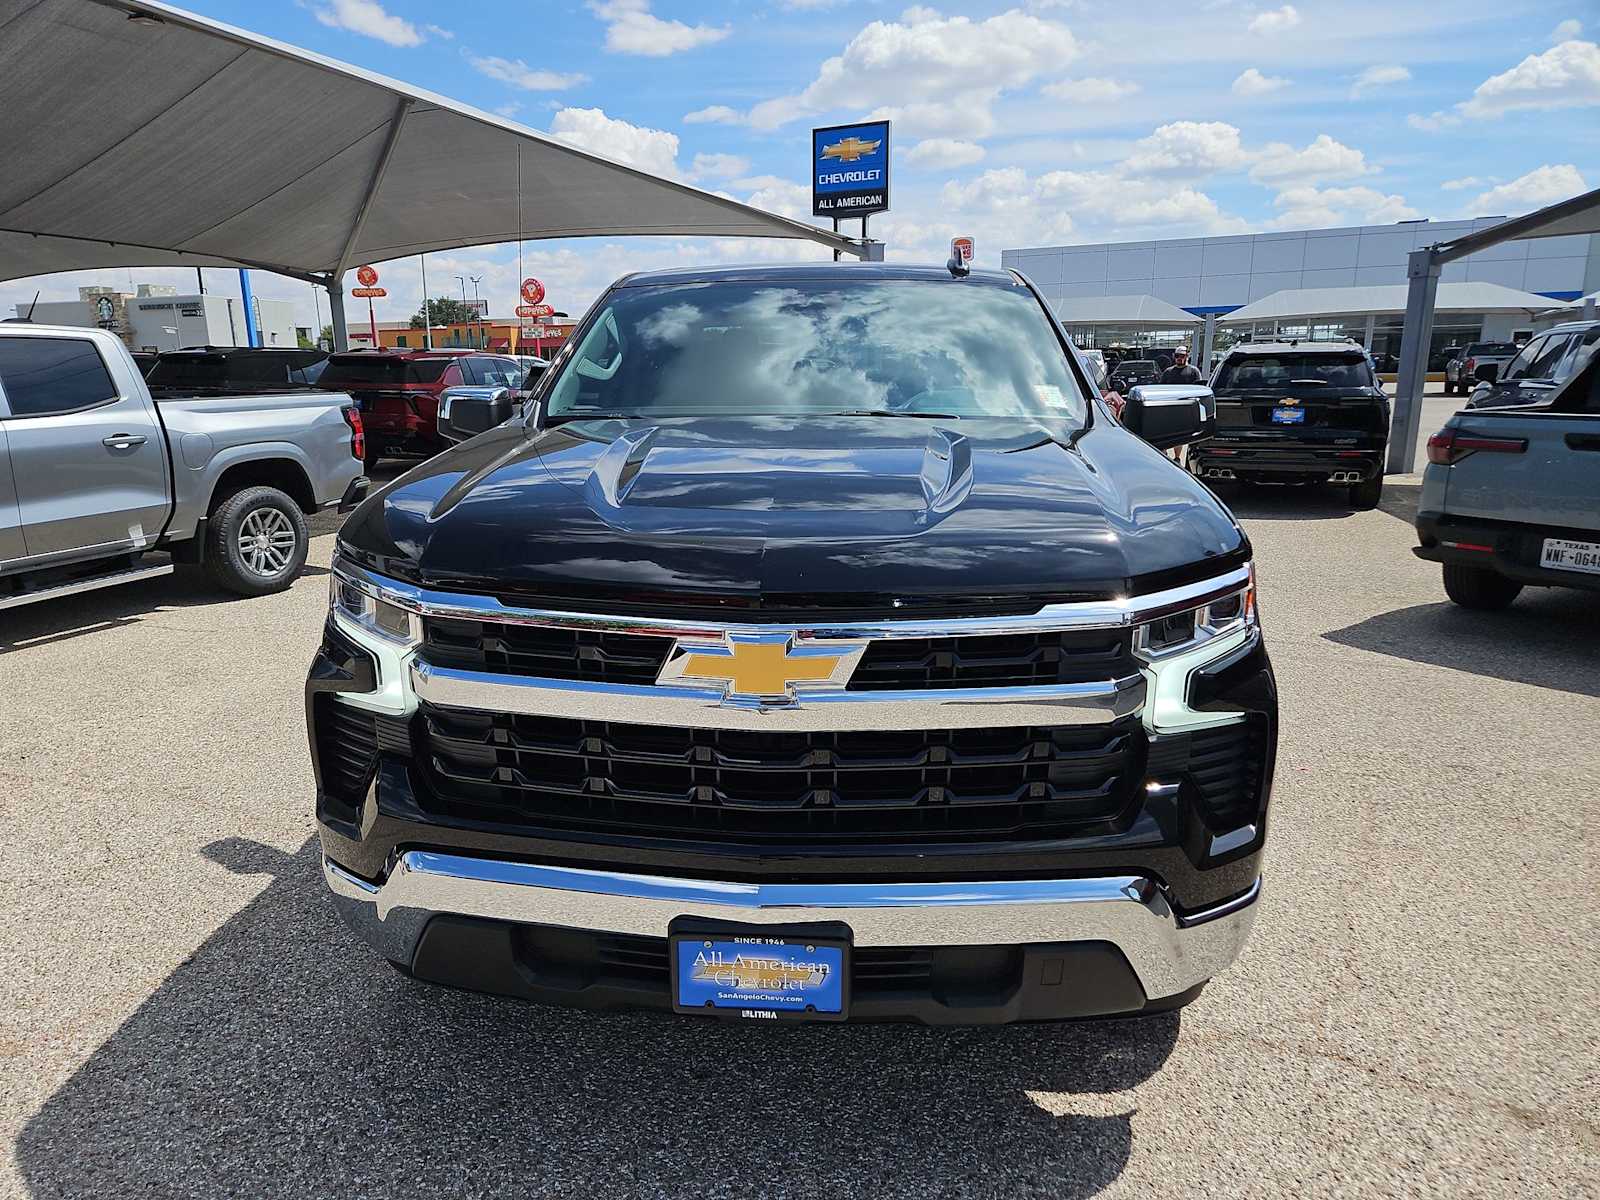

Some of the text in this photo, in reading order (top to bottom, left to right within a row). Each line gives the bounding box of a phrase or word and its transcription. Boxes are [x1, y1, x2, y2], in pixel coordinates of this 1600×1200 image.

[818, 169, 881, 185] CHEVROLET
[818, 194, 882, 209] ALL AMERICAN
[1564, 542, 1590, 551] TEXAS
[734, 937, 762, 945] SINCE
[693, 951, 831, 974] All American
[714, 970, 805, 991] Chevrolet
[717, 991, 803, 1003] SanAngeloChevy.com
[750, 1010, 778, 1020] LITHIA
